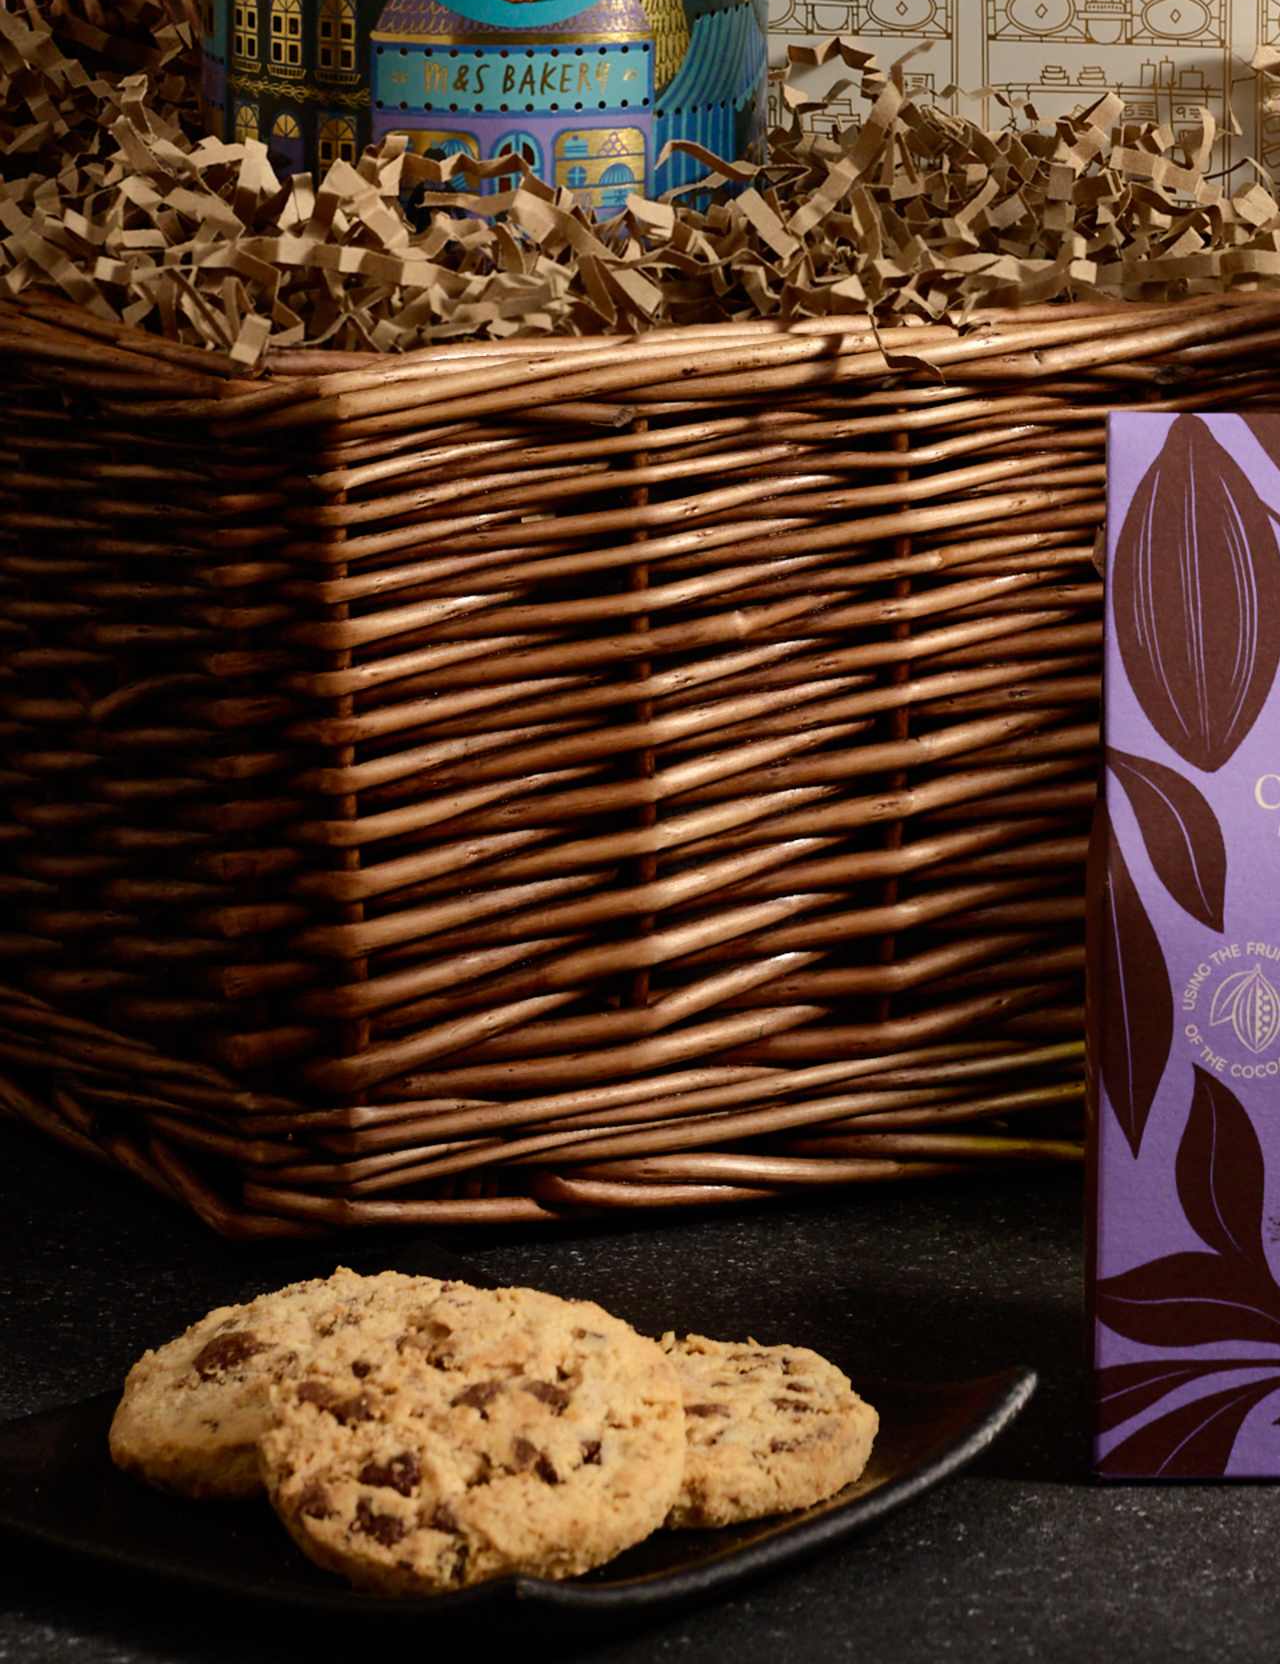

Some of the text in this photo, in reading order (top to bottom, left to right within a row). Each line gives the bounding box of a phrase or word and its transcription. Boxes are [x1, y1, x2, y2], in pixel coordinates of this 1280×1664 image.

[423, 61, 610, 96] M&S BAKERY
[1182, 963, 1212, 1010] USING
[1208, 944, 1242, 966] THE
[1184, 1023, 1203, 1046] OF
[1200, 1046, 1229, 1072] THE
